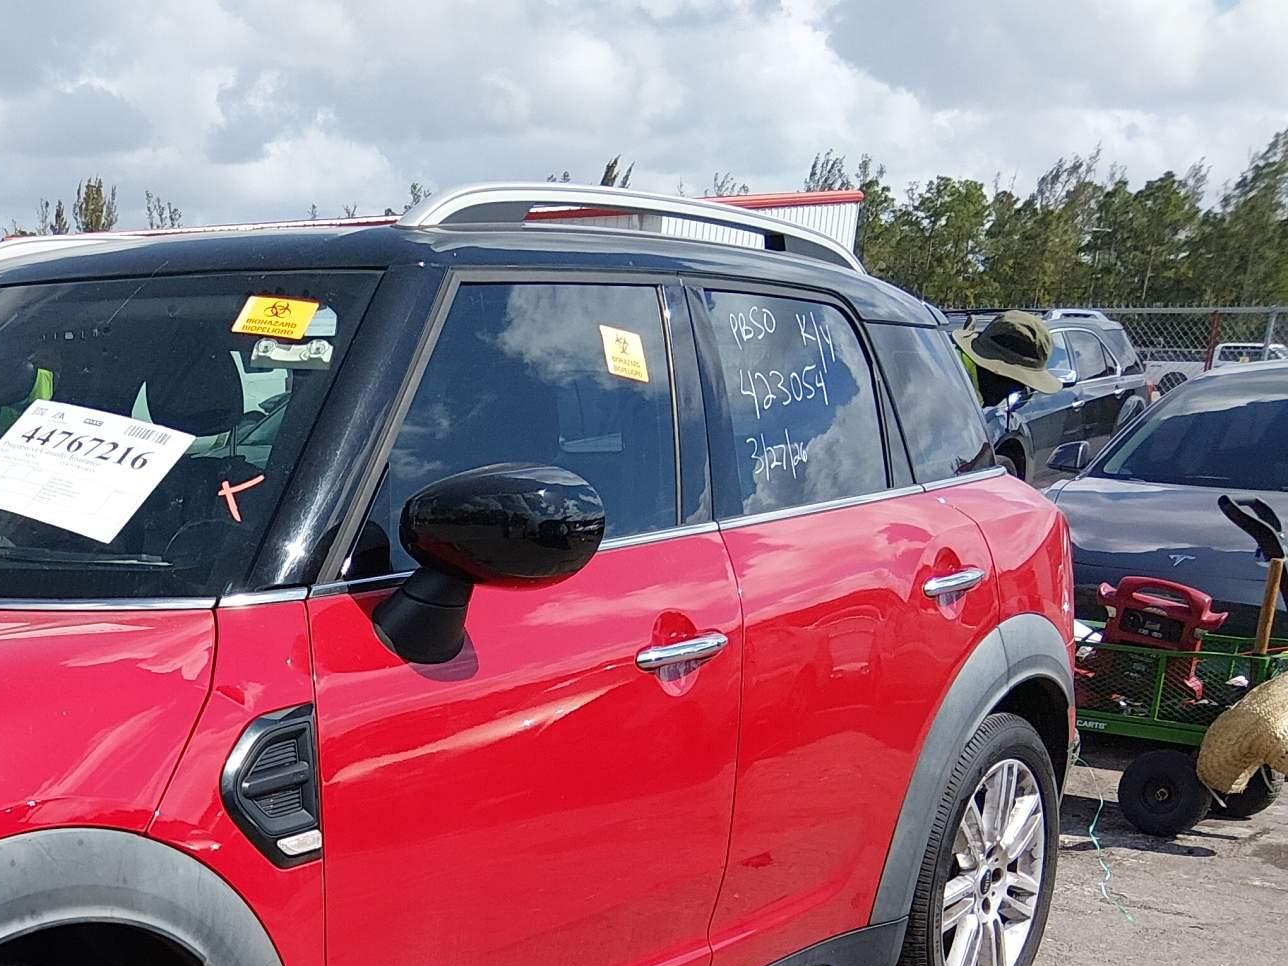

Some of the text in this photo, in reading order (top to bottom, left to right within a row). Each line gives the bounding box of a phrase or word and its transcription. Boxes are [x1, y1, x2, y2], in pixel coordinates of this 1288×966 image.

[728, 305, 777, 351] PBSO
[738, 364, 829, 420] 423054
[21, 425, 155, 471] 44767216
[746, 428, 808, 481] 3/27/26
